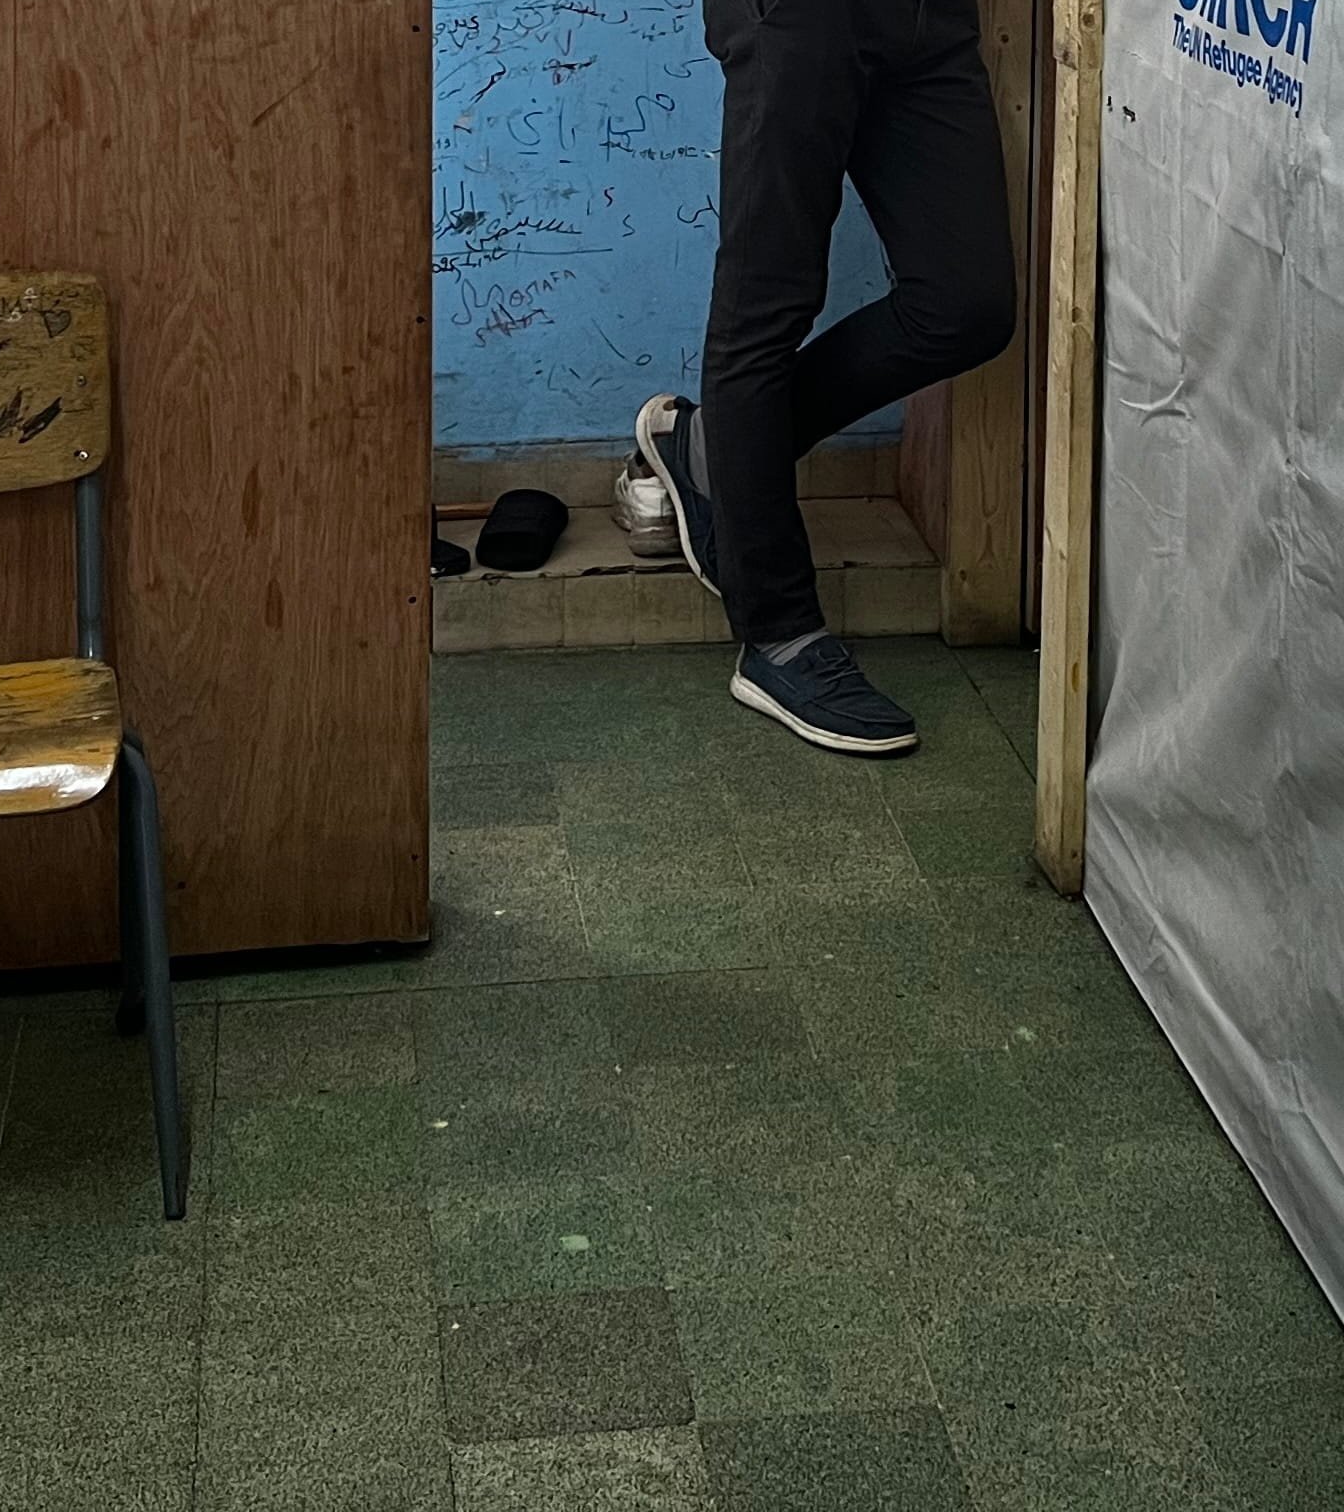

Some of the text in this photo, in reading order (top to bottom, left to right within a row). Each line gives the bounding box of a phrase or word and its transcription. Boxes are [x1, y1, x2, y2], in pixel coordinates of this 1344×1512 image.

[1173, 13, 1190, 54] The
[1188, 21, 1202, 62] UN
[1202, 31, 1262, 88] Refugee
